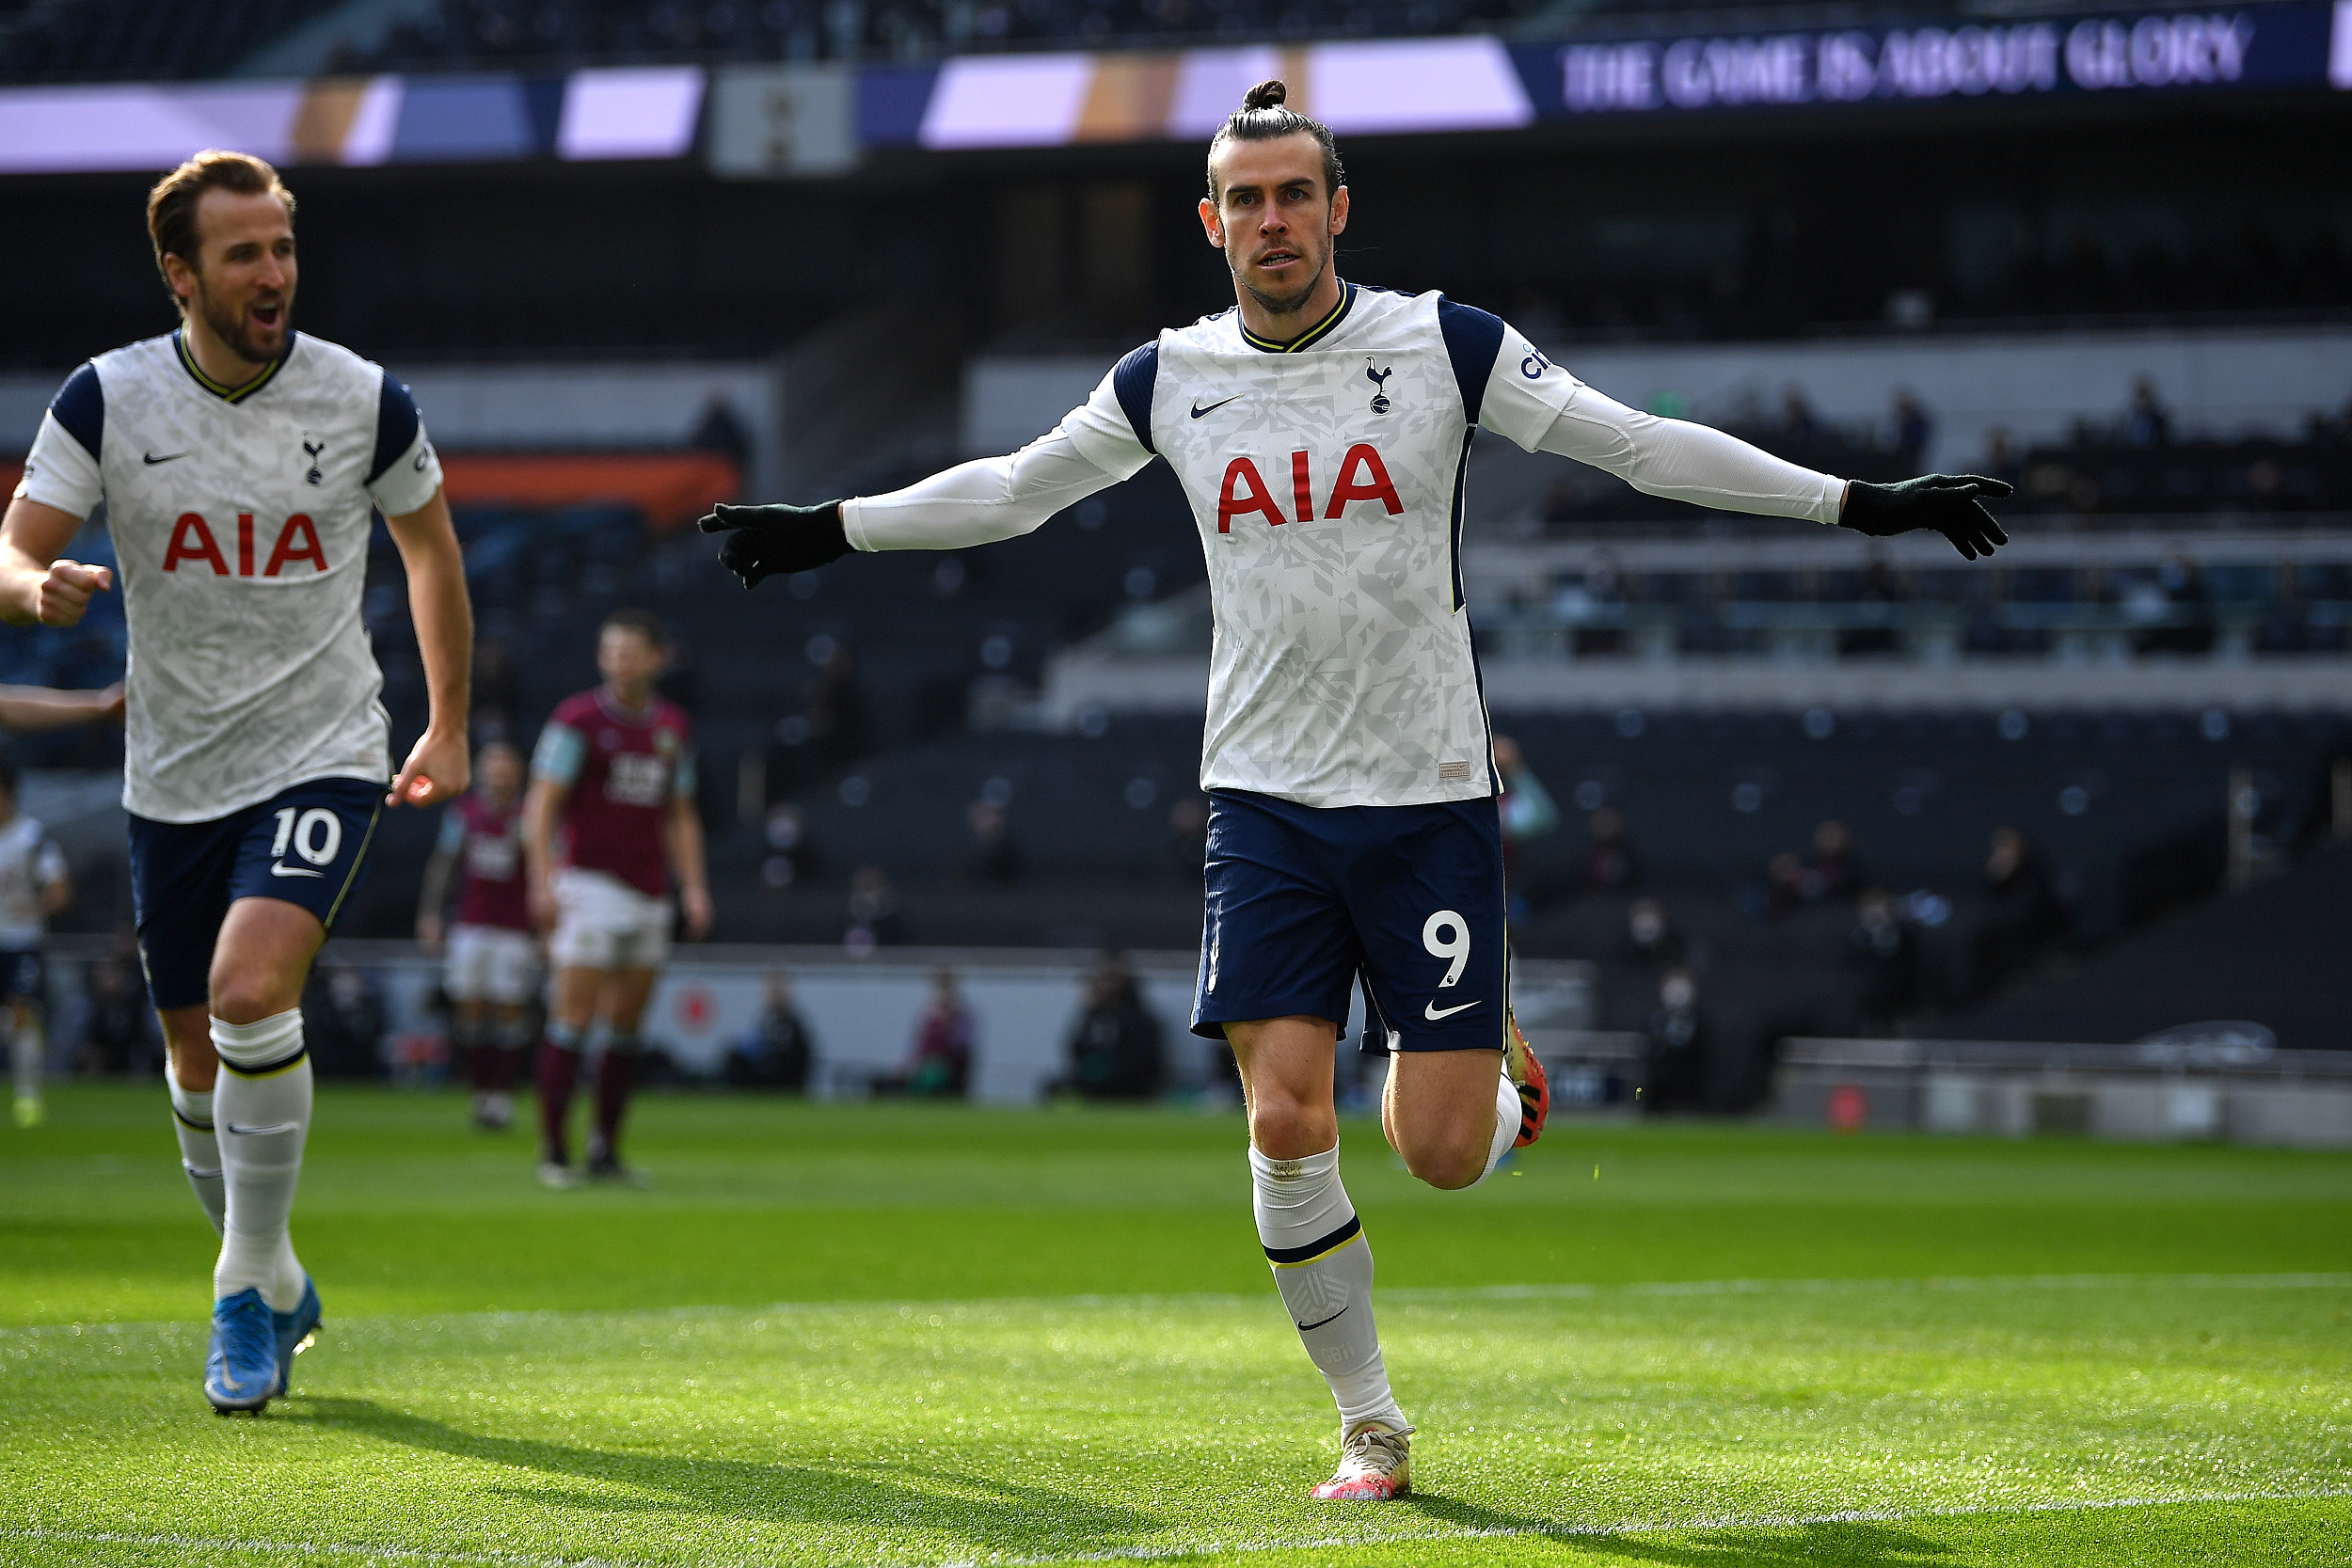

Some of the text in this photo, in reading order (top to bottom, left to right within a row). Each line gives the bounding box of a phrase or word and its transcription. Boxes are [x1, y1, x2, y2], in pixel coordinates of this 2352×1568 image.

[1564, 12, 2254, 111] THE GAME IS ABOUT GLORY
[1217, 442, 1406, 534] AIA
[163, 511, 328, 577] AIA
[270, 806, 342, 866] 10
[1422, 910, 1470, 989] 9
